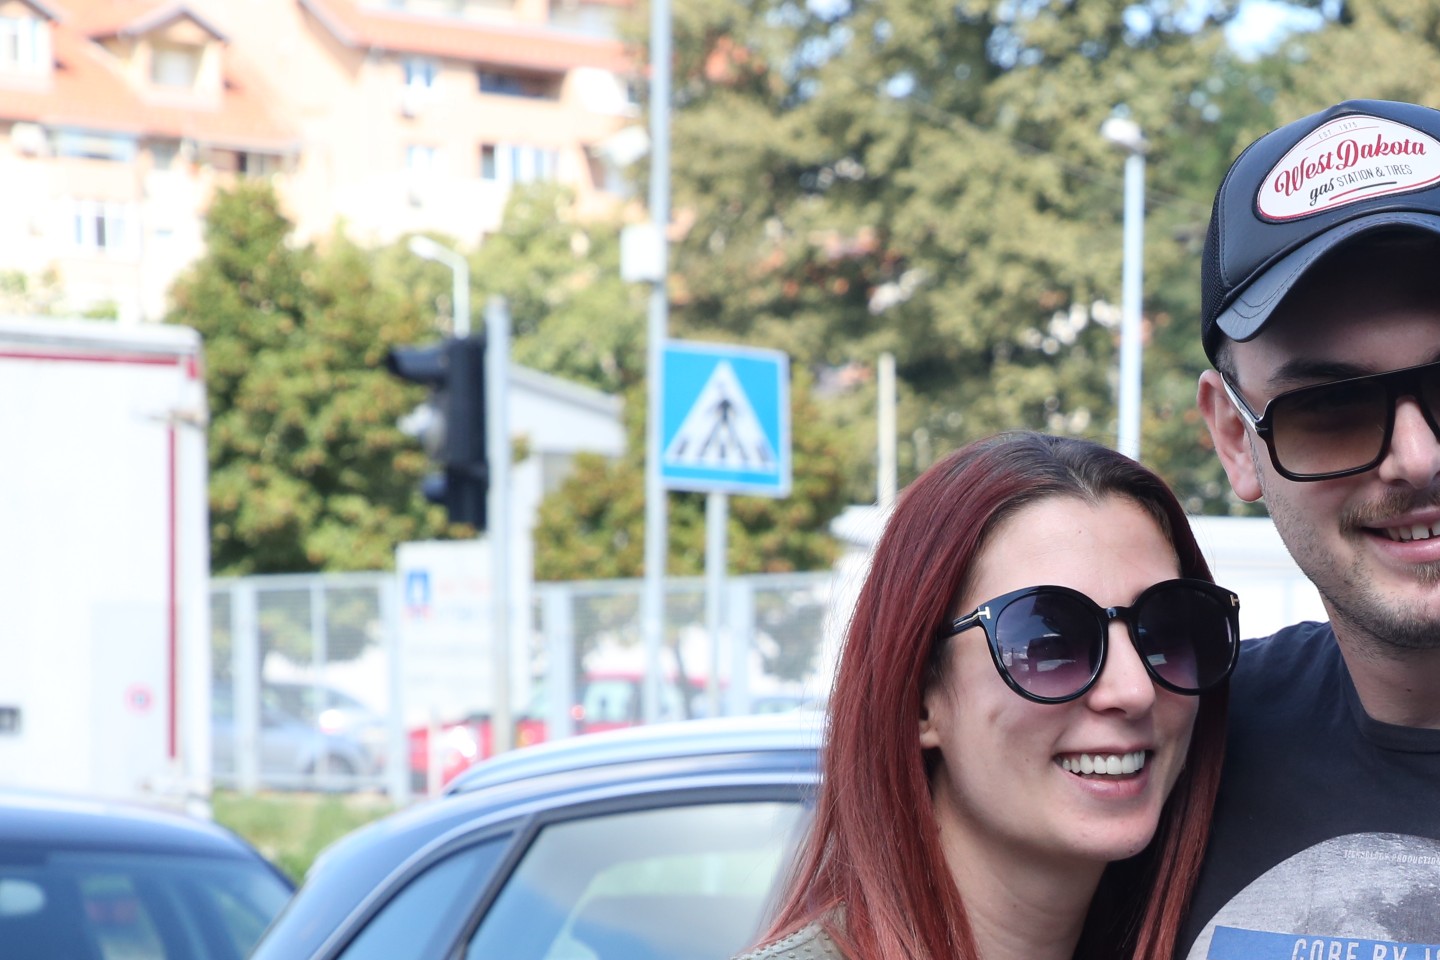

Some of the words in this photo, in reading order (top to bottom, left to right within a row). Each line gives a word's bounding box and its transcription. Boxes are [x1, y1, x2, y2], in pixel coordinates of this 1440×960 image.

[1274, 151, 1335, 196] West
[1336, 134, 1427, 170] Dakota
[1309, 177, 1335, 206] gas
[1337, 168, 1375, 187] STATION
[1375, 166, 1386, 177] &
[1387, 164, 1413, 176] TIRES
